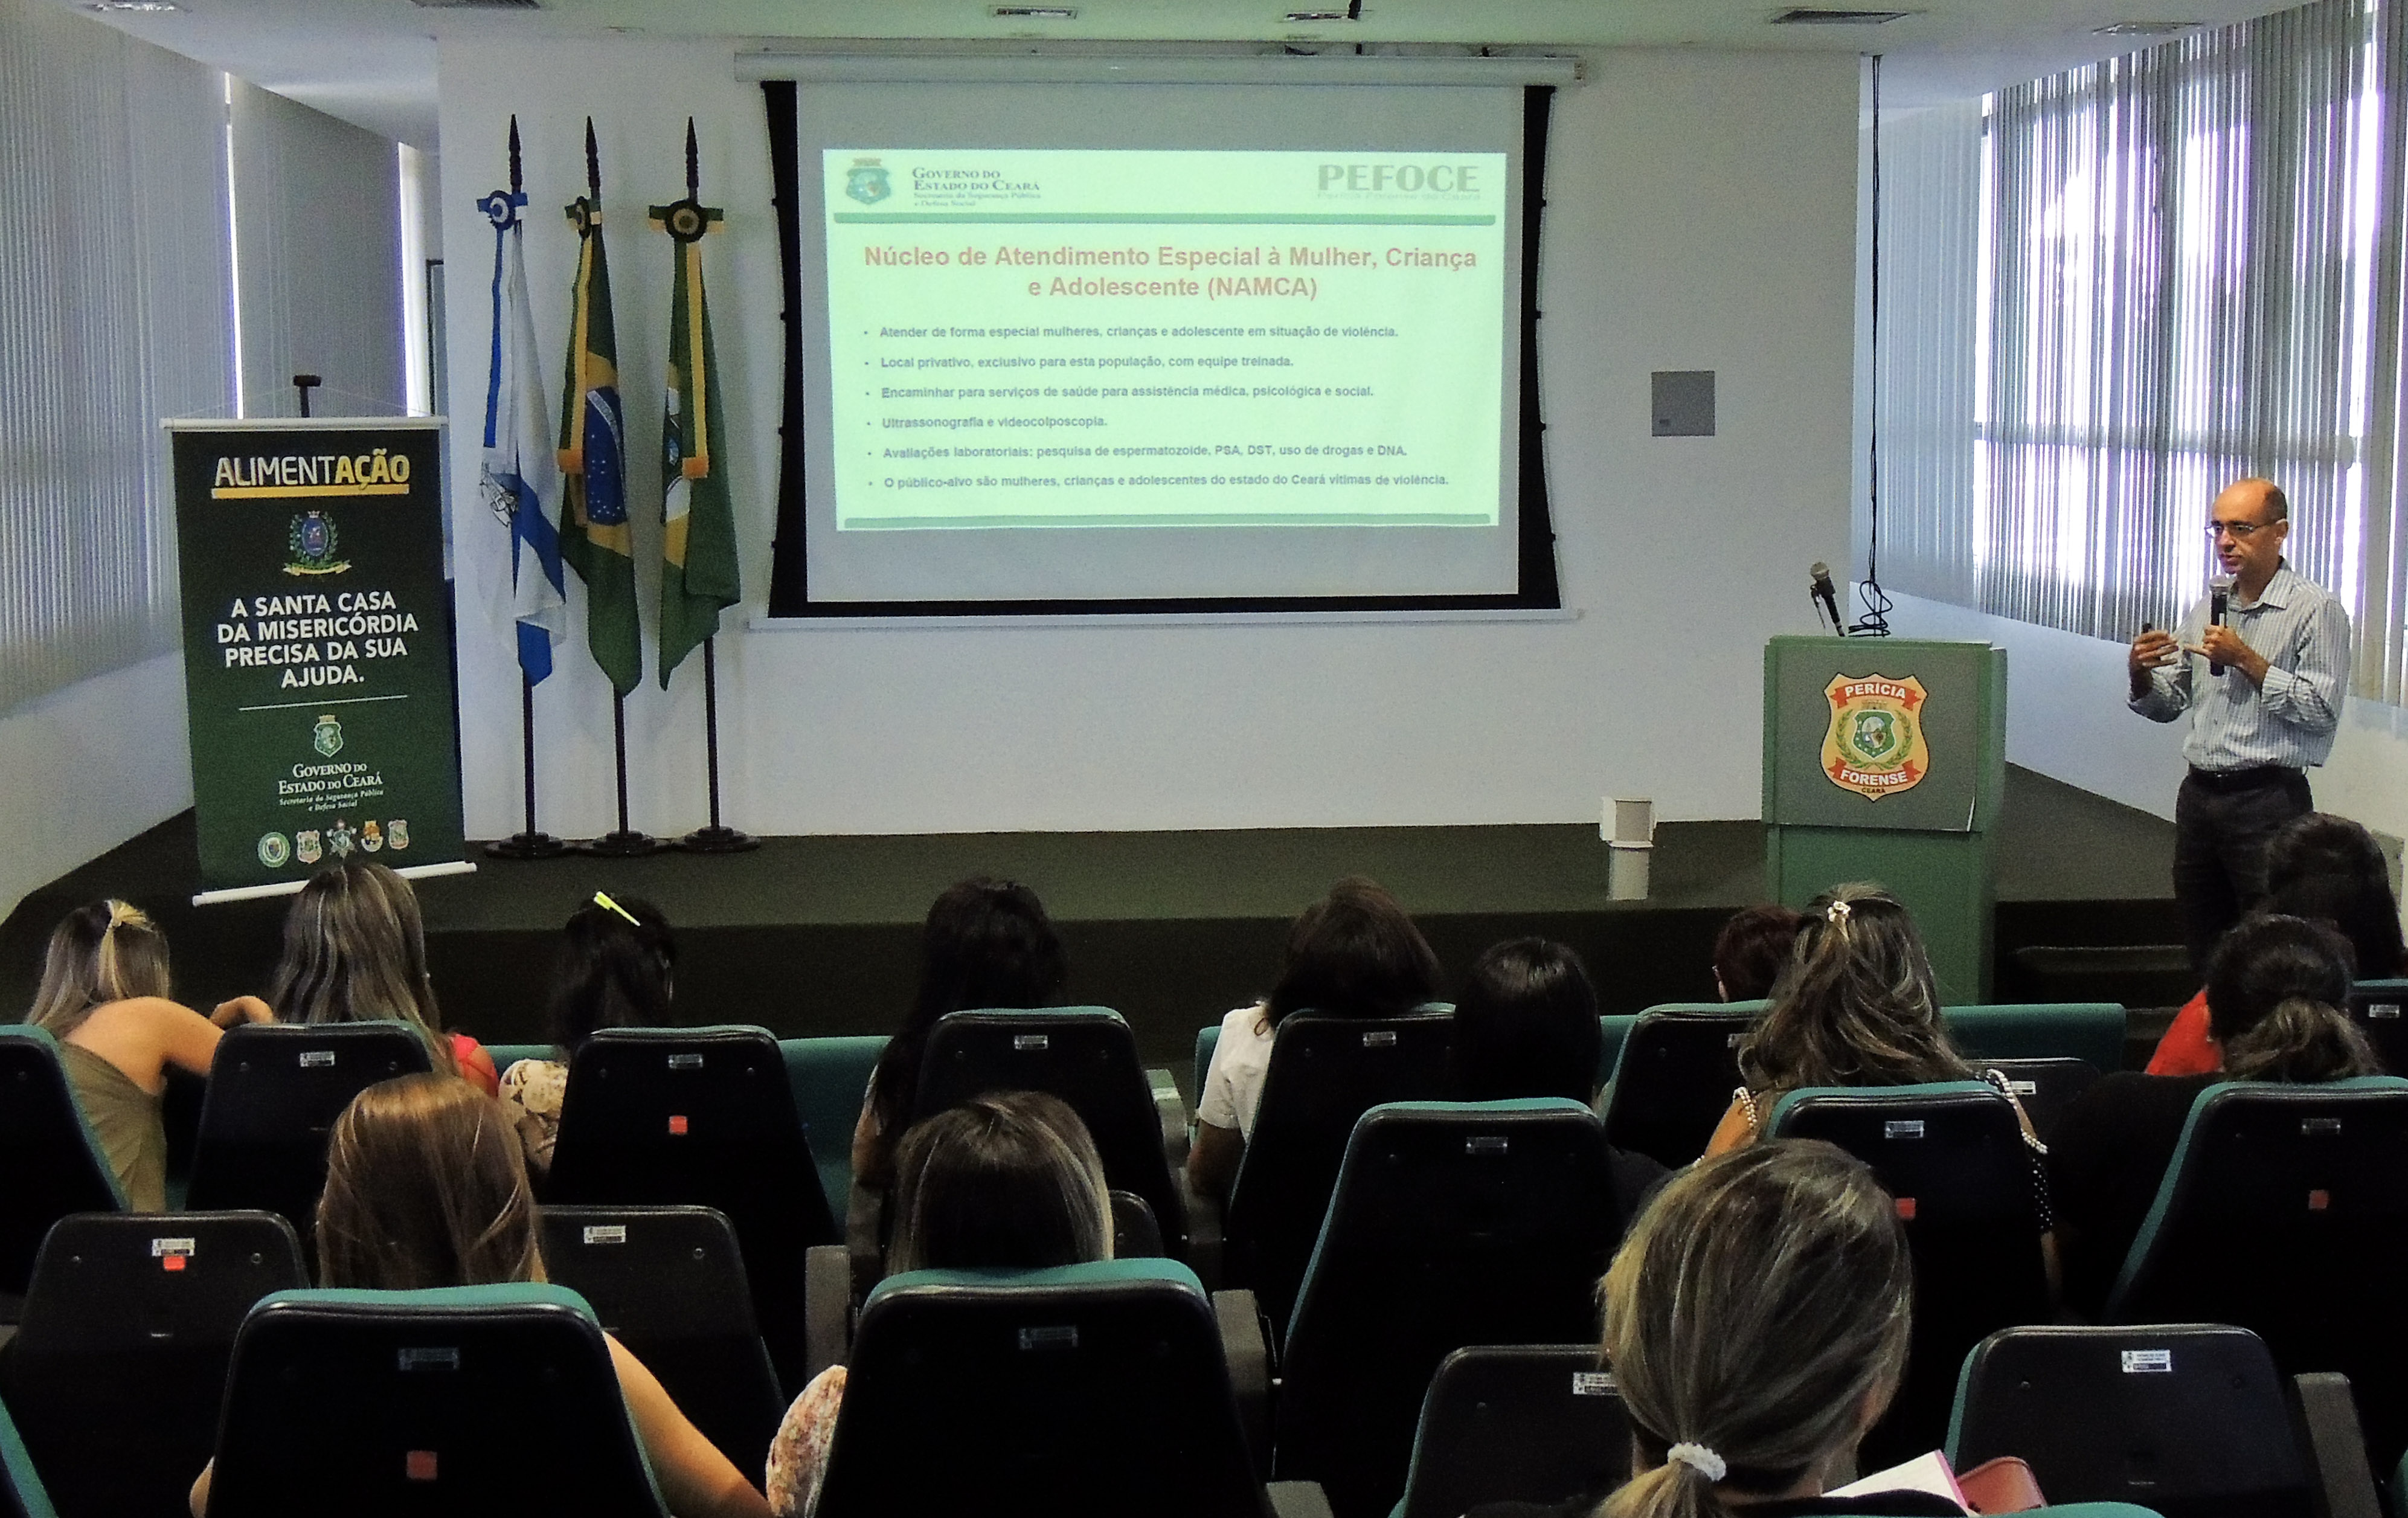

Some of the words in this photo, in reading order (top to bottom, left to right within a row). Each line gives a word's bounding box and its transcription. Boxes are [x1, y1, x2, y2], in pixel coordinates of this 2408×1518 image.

[1318, 164, 1480, 191] PEFOCE
[865, 246, 949, 266] Núcleo
[958, 246, 986, 265] de
[995, 246, 1149, 266] Atendimento
[1159, 246, 1259, 270] Especial
[1268, 246, 1280, 266] à
[1290, 246, 1377, 269] Mulher,
[1386, 248, 1477, 271] Criança
[1029, 281, 1041, 296] e
[1050, 277, 1199, 296] Adolescente
[1208, 277, 1317, 301] (NAMCA)
[880, 327, 926, 337] Atender
[932, 327, 946, 337] de
[950, 327, 985, 337] forma
[989, 327, 1039, 338] especial
[1043, 327, 1102, 336] mulheres,
[1107, 327, 1157, 338] crianças
[1172, 327, 1244, 336] adolescente
[1270, 326, 1320, 338] situação
[1324, 327, 1338, 336] de
[1342, 327, 1398, 336] violência.
[881, 358, 914, 368] Local
[918, 358, 974, 369] privativo,
[978, 357, 1035, 367] exclusivo
[1039, 358, 1066, 369] para
[1070, 358, 1094, 367] esta
[1099, 356, 1164, 368] população,
[1198, 356, 1238, 368] equipe
[1242, 356, 1293, 366] treinada.
[882, 387, 954, 398] Encaminhar
[958, 389, 984, 399] para
[989, 388, 1039, 398] serviços
[1044, 387, 1058, 396] de
[1062, 386, 1097, 397] saúde
[1102, 388, 1128, 398] para
[1132, 387, 1198, 396] assistência
[1203, 386, 1248, 396] médica,
[1253, 387, 1321, 398] psicológica
[1335, 387, 1373, 396] social.
[882, 417, 983, 429] Ultrassonografia
[987, 419, 994, 427] e
[998, 417, 1107, 428] videocolposcopia.
[884, 447, 949, 459] Avaliações
[954, 448, 1033, 457] laboratoriais:
[1037, 447, 1091, 458] pesquisa
[1095, 446, 1109, 456] de
[1113, 446, 1211, 458] espermatozoide,
[1215, 445, 1242, 455] PSA,
[1248, 445, 1275, 455] DST,
[1305, 445, 1318, 455] de
[1323, 446, 1363, 457] drogas
[1378, 445, 1407, 455] DNA.
[215, 448, 409, 490] ALIMENTAÇÃO
[885, 478, 894, 487] O
[898, 477, 972, 489] público-alvo
[977, 476, 997, 486] são
[1001, 477, 1060, 486] mulheres,
[1064, 477, 1114, 487] crianças
[1129, 476, 1207, 485] adolescentes
[1211, 475, 1225, 484] do
[1230, 475, 1269, 484] estado
[1273, 475, 1288, 484] do
[1291, 474, 1324, 484] Ceará
[1375, 475, 1390, 485] de
[1393, 475, 1448, 484] violência.
[231, 598, 248, 618] A
[255, 594, 331, 616] SANTA
[338, 591, 396, 613] CASA
[217, 623, 251, 643] DA
[258, 612, 419, 641] MISERICÓRDIA
[225, 643, 320, 667] PRECISA
[327, 641, 359, 660] DA
[365, 637, 408, 658] SUA
[281, 664, 365, 689] AJUDA.
[1840, 769, 1908, 786] FORENSE
